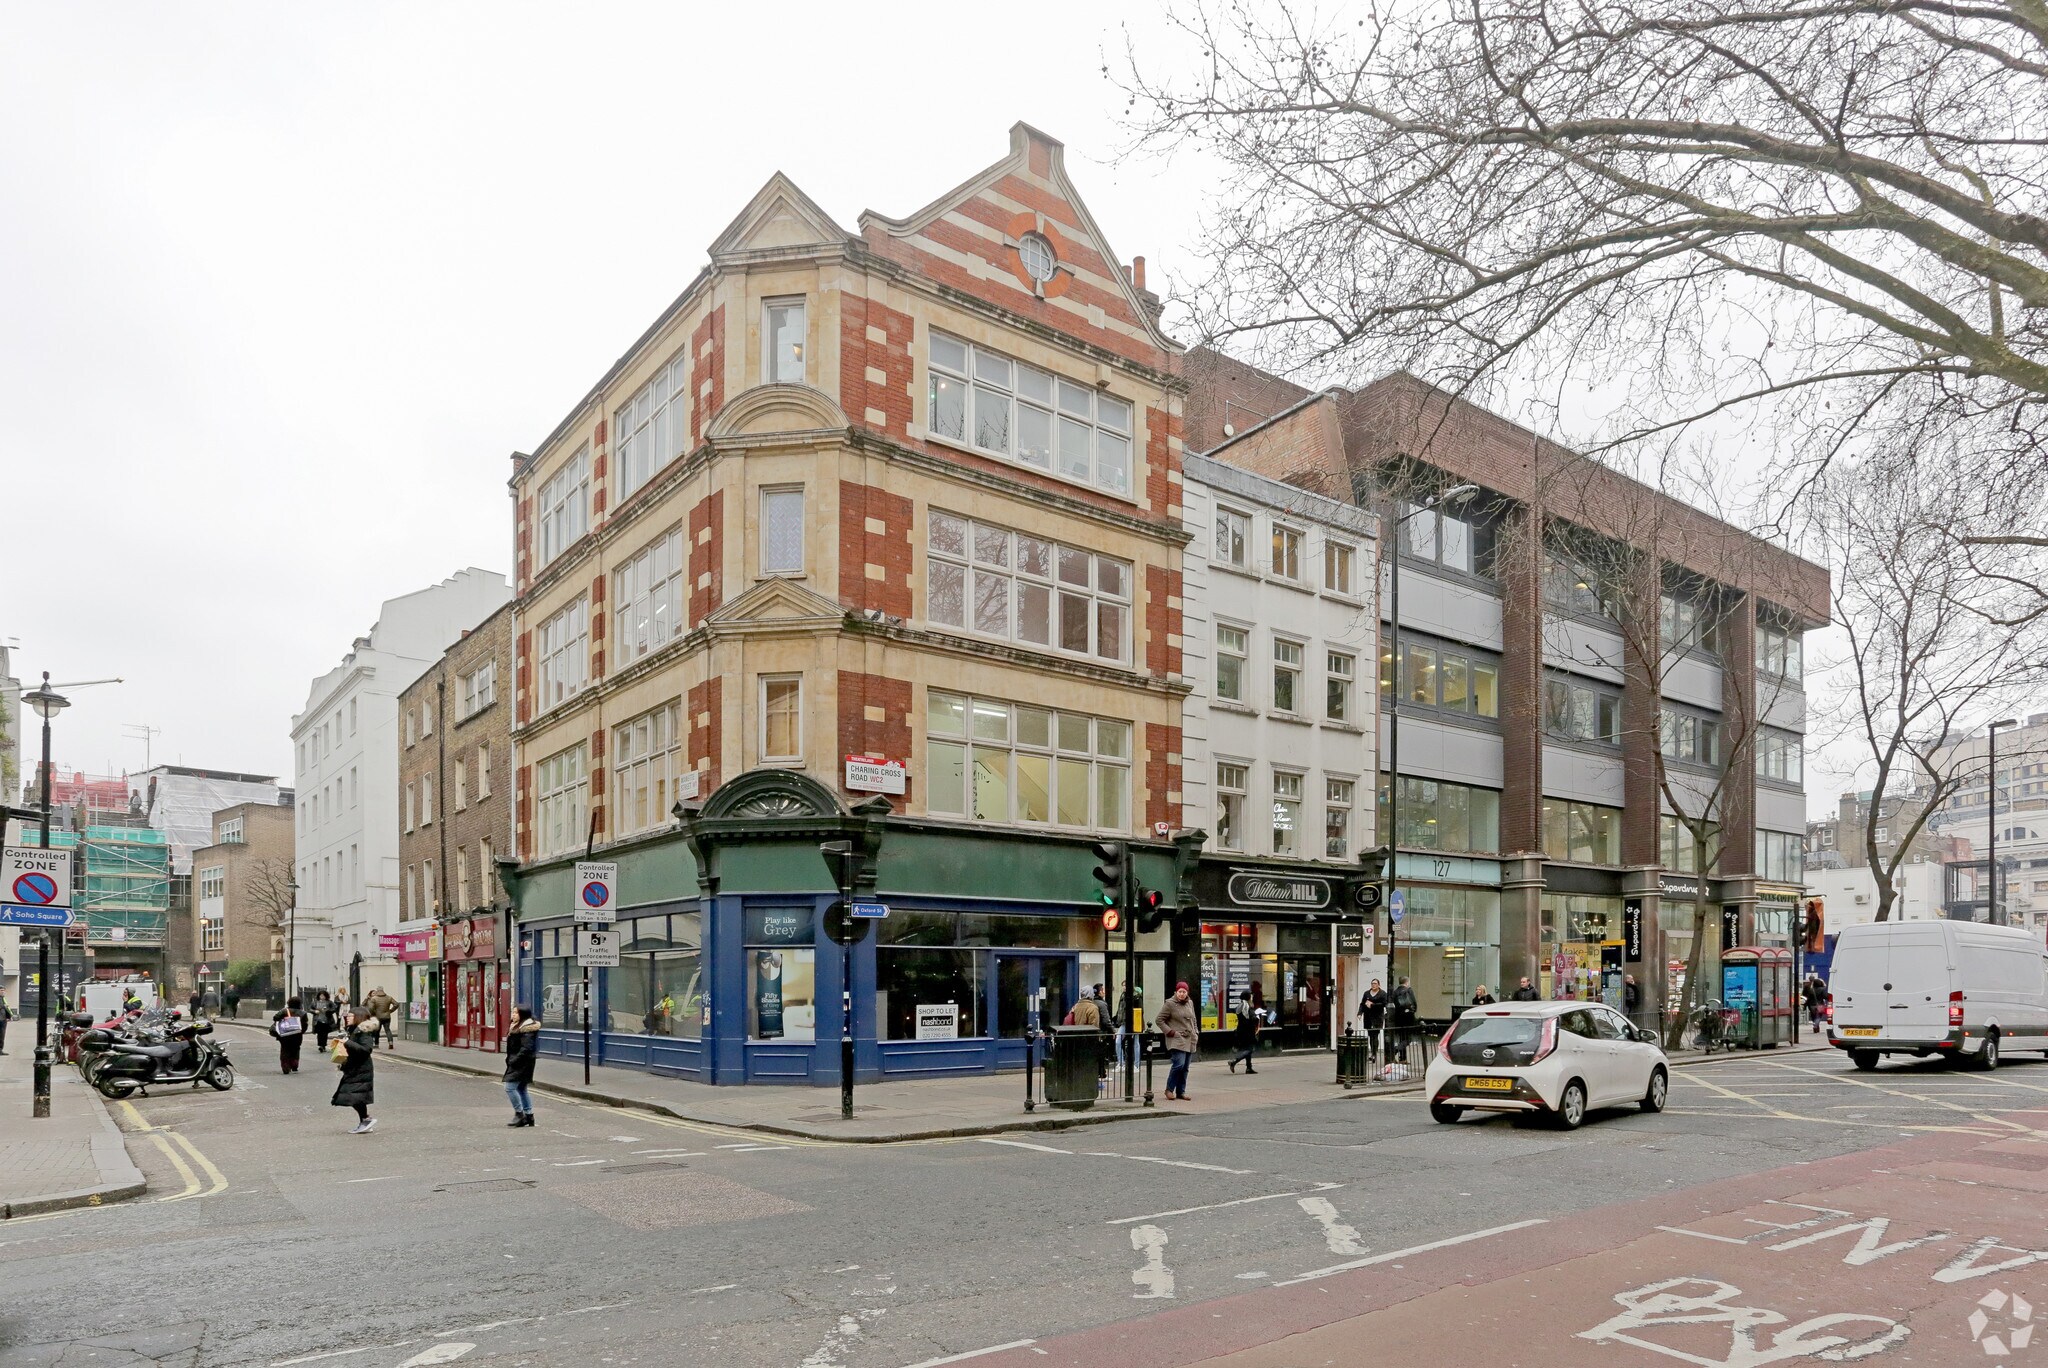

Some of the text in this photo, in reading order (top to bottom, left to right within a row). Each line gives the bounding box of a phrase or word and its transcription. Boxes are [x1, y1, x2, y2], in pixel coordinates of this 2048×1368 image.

[850, 765, 902, 778] CHARING CROSS
[850, 774, 868, 782] ROAD
[5, 850, 66, 860] Controlled
[14, 860, 56, 870] ZONE
[1433, 860, 1451, 877] 127
[1244, 878, 1318, 900] William HILL
[764, 924, 796, 938] Grey
[1631, 908, 1640, 956] Superdrug
[380, 936, 399, 946] Massage
[923, 1017, 952, 1025] nashbond
